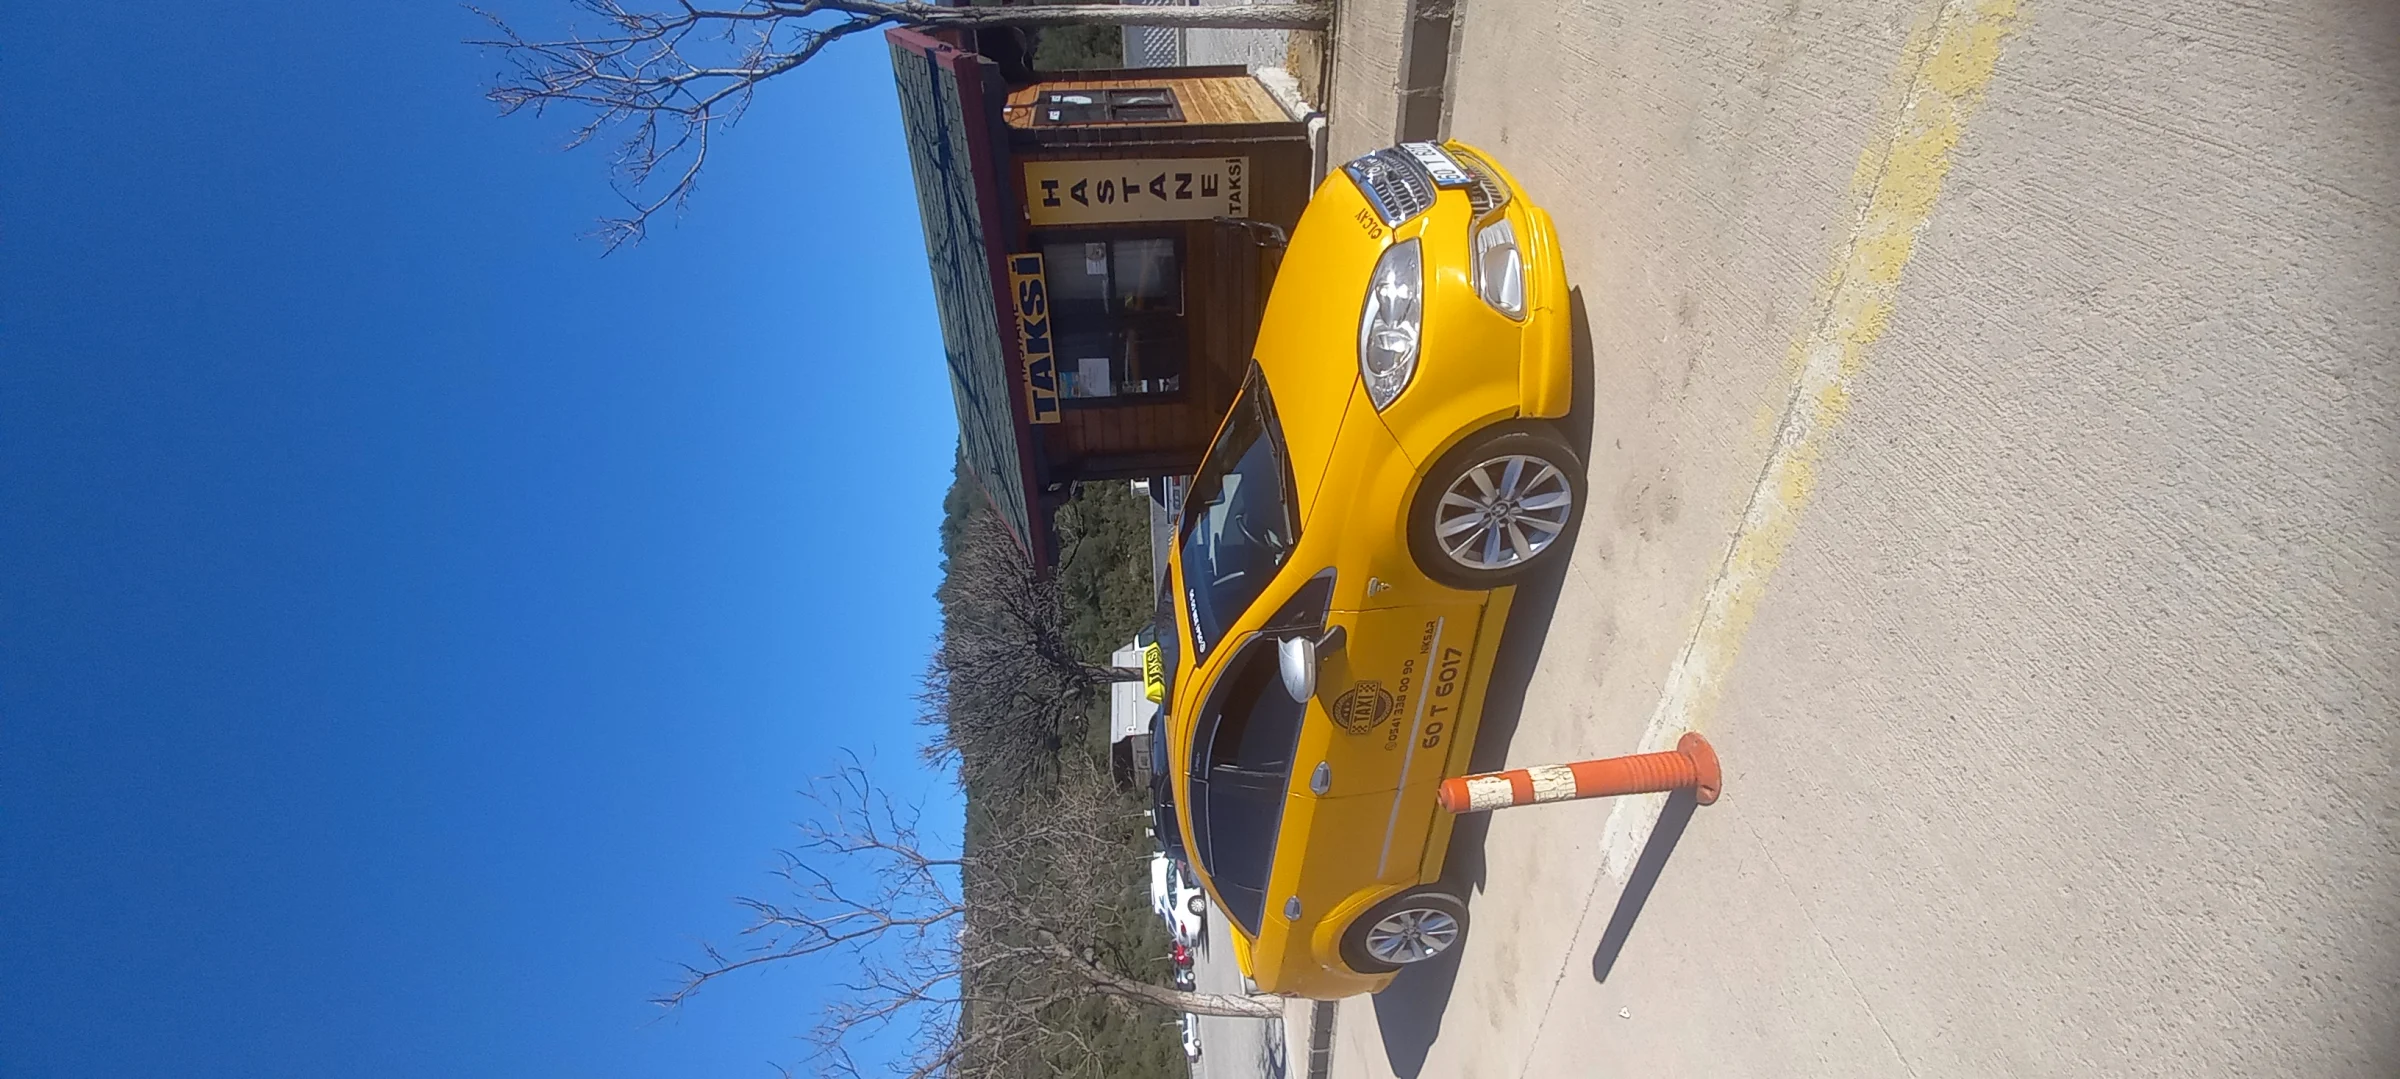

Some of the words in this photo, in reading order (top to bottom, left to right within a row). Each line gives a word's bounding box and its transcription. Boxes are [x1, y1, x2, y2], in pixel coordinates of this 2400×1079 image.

[1433, 170, 1460, 179] 60
[1041, 172, 1218, 207] HASTANE
[1354, 208, 1382, 239] OLCAY
[1012, 258, 1056, 421] TAKSİ
[1403, 660, 1414, 674] 90
[1436, 647, 1462, 697] 6017
[1399, 677, 1410, 692] 00
[1354, 696, 1374, 722] TAXI
[1430, 704, 1448, 716] T
[1388, 718, 1400, 740] 0541
[1422, 722, 1444, 748] 60
